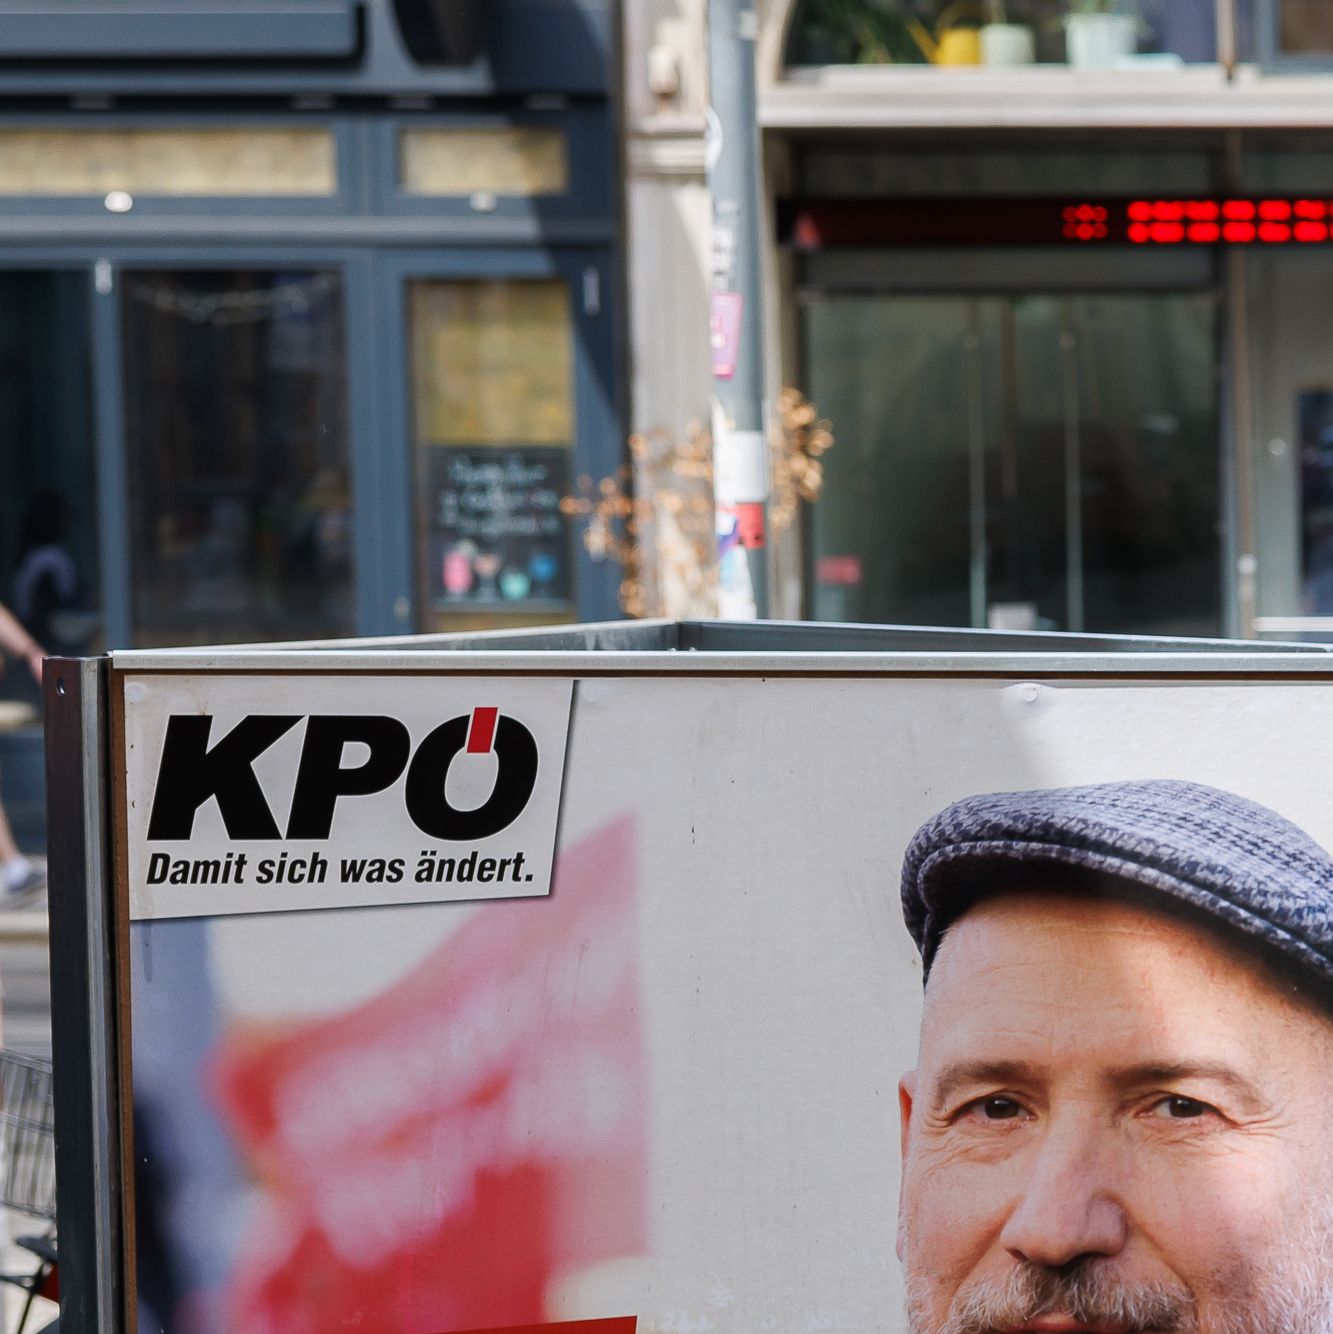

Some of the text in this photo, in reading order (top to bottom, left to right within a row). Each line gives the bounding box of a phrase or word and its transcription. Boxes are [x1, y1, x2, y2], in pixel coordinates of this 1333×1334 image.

[147, 708, 538, 841] KPÖ
[147, 851, 533, 884] Damit sich was ändert.
